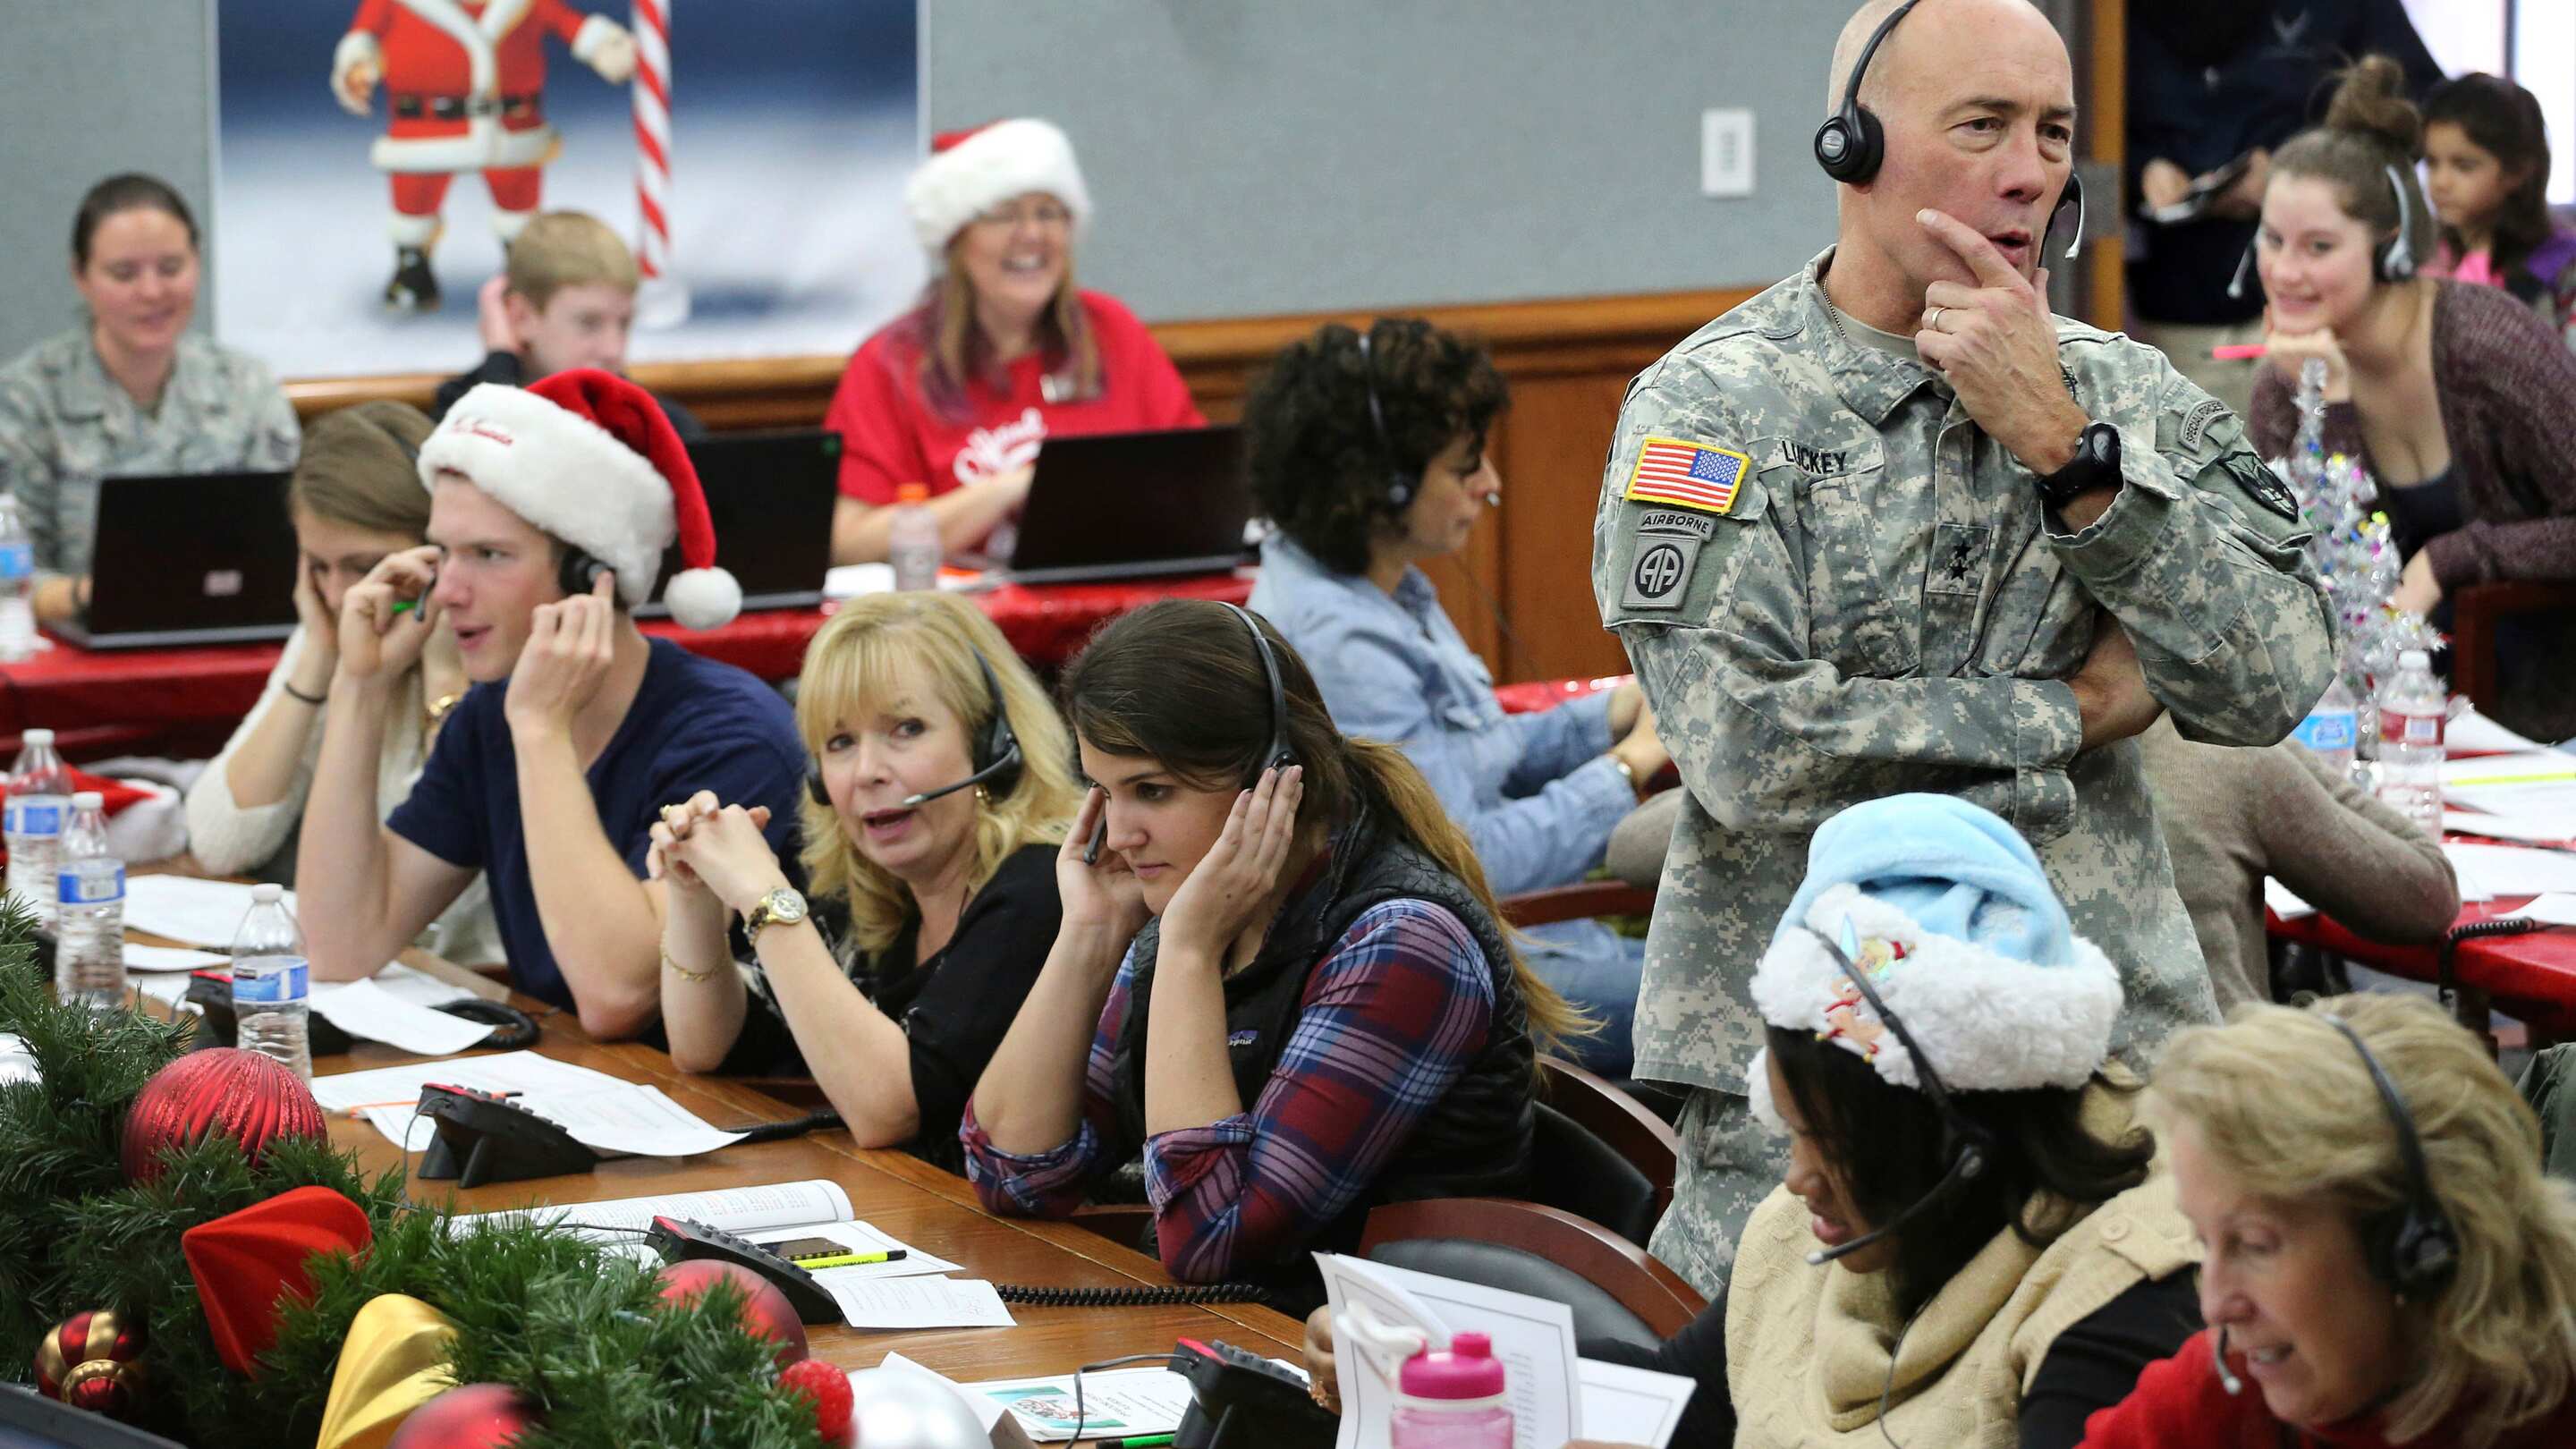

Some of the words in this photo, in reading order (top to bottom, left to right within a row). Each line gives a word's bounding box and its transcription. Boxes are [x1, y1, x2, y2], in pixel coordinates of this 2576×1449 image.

[2185, 414, 2204, 444] SPECIAL
[1782, 440, 1847, 474] LUCKEY
[1641, 514, 1709, 534] AIRBORNE
